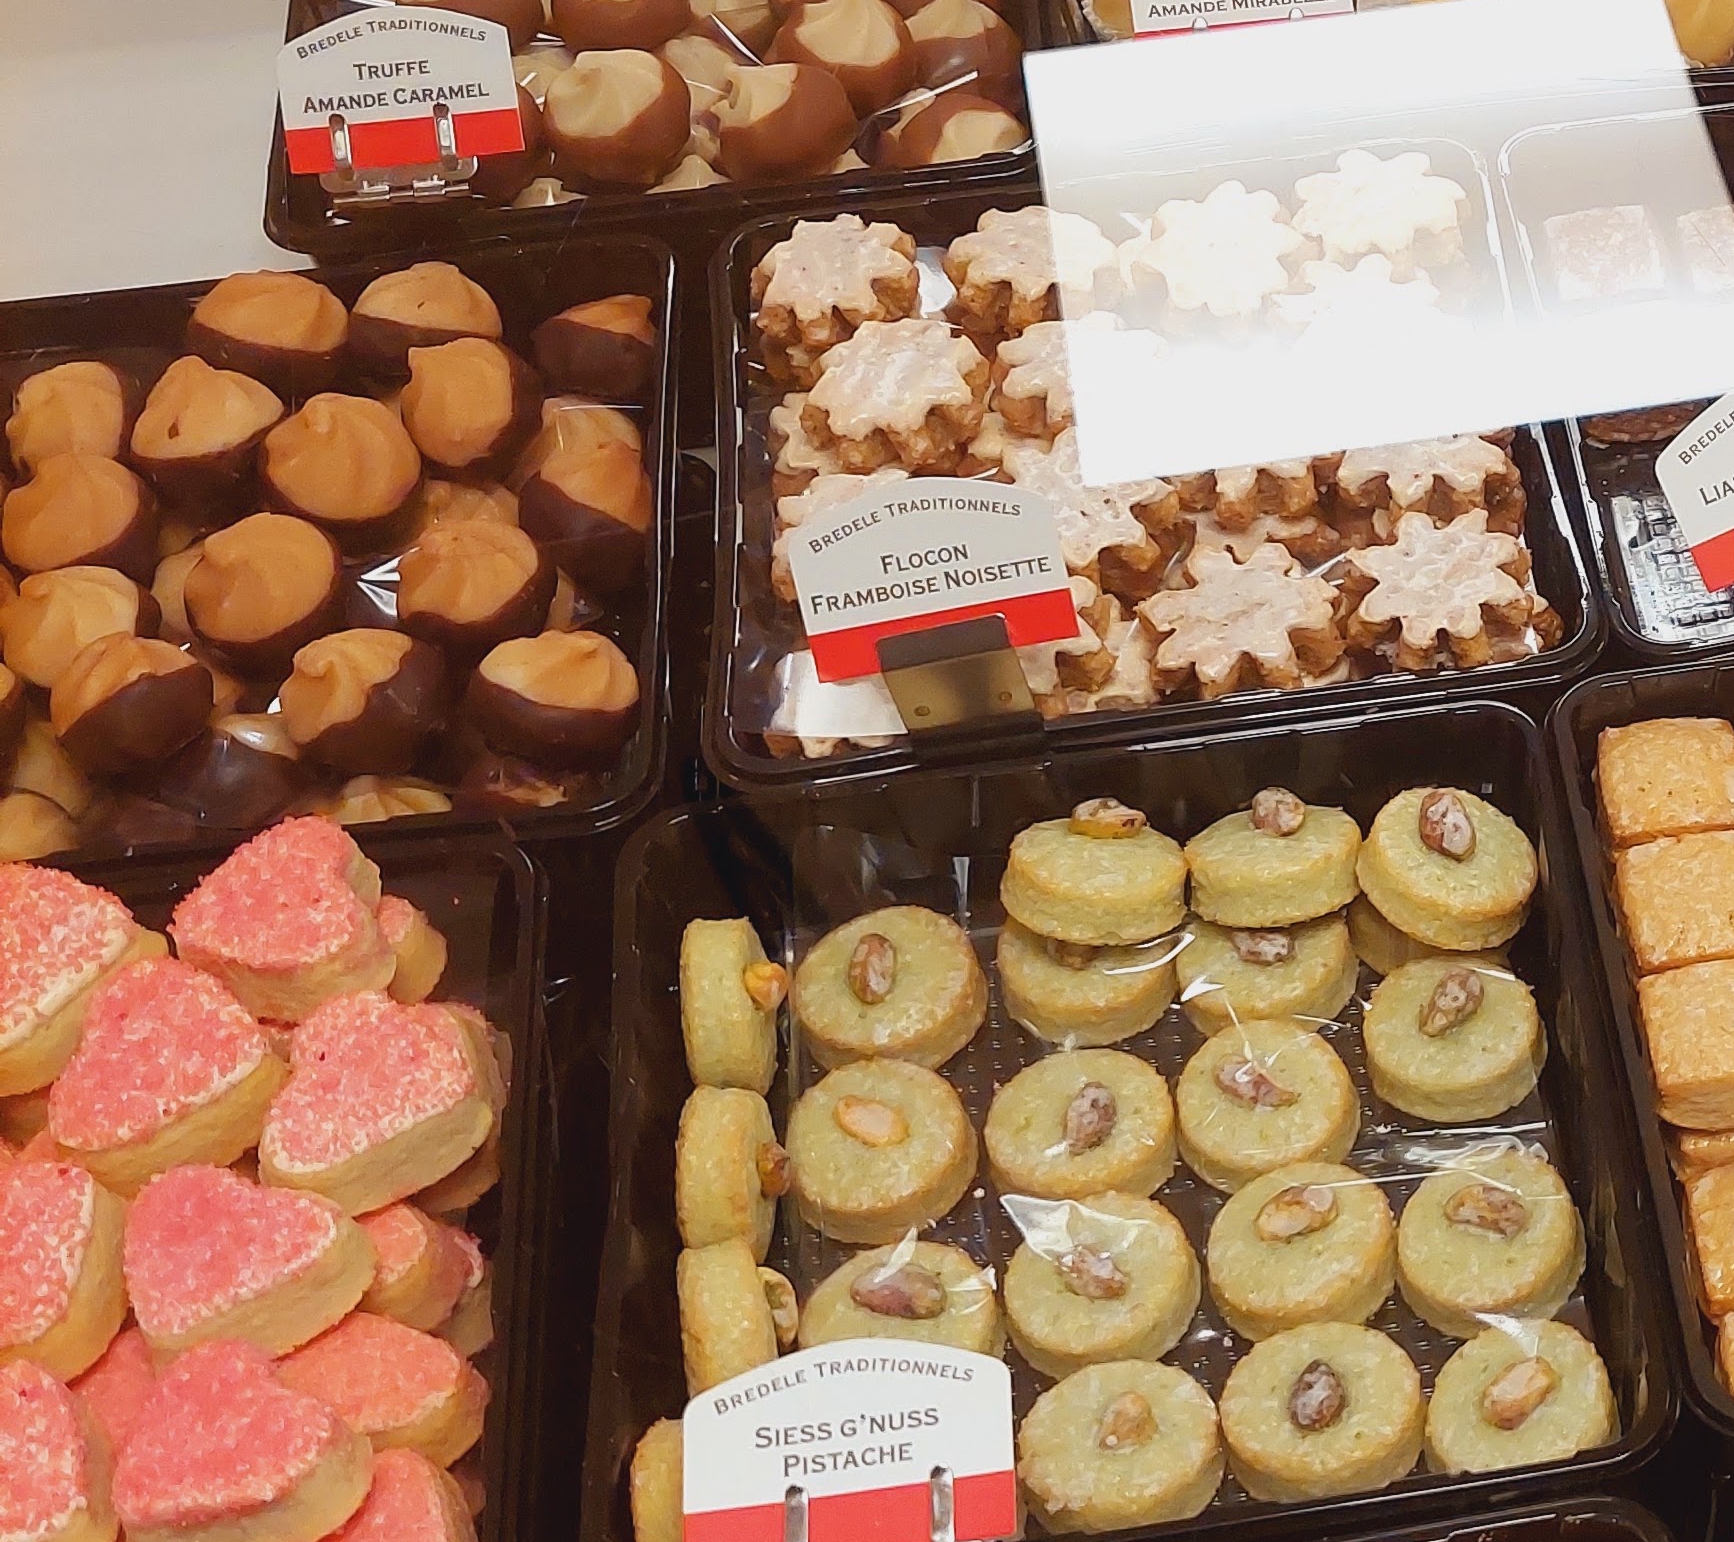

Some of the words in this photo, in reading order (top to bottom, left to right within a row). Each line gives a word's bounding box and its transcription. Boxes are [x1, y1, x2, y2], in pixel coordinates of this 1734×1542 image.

[1148, 0, 1228, 19] AMANDE
[296, 26, 363, 59] BREDELE
[366, 19, 486, 42] TRADITIONNELS
[353, 60, 431, 81] TRUFFE
[303, 91, 389, 114] AMANDE
[393, 83, 490, 105] CARAMEL
[808, 511, 881, 555] BREDELE
[884, 497, 1021, 518] TRADITIONNELS
[880, 544, 969, 575] FLOCON
[810, 577, 941, 615] FRAMBOISE
[944, 556, 1052, 590] NOISETTE
[713, 1369, 807, 1416] BREDELE
[813, 1357, 975, 1382] TRADITIONNELS
[755, 1422, 833, 1449] SIESS
[840, 1408, 940, 1438] G'NUSS
[782, 1442, 913, 1478] PISTACHE
